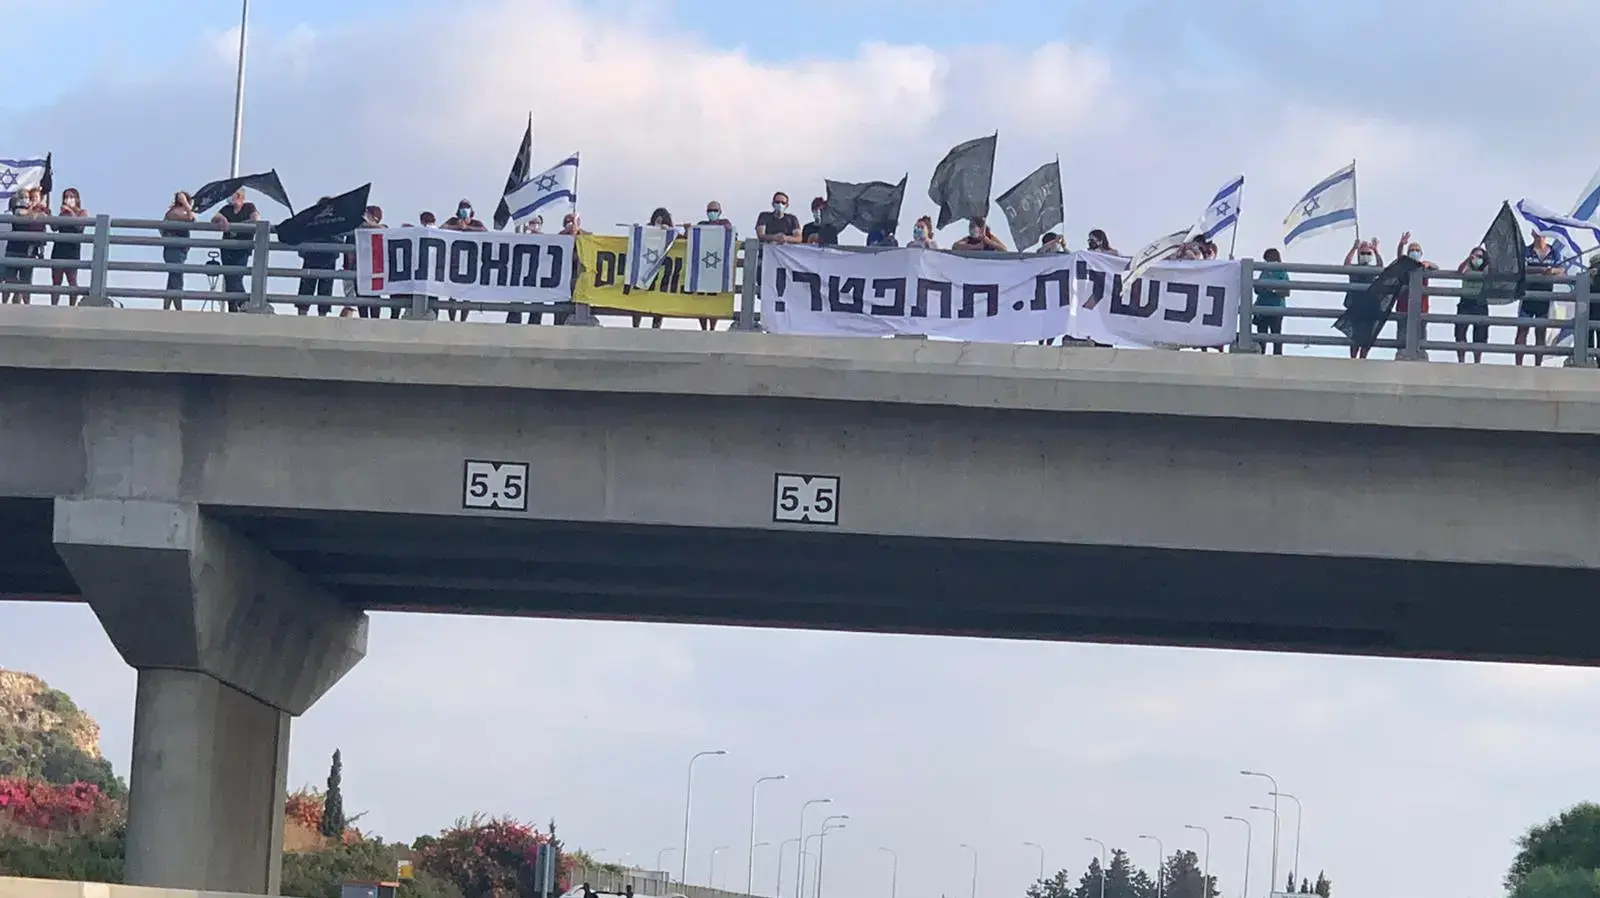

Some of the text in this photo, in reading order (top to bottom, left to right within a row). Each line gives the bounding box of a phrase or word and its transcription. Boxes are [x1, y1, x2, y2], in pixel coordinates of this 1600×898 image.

[370, 234, 564, 290] נמאסתם!
[774, 260, 1226, 327] נכשלת. תתפטר!
[470, 473, 523, 500] 5.5
[780, 486, 834, 513] 5.5
